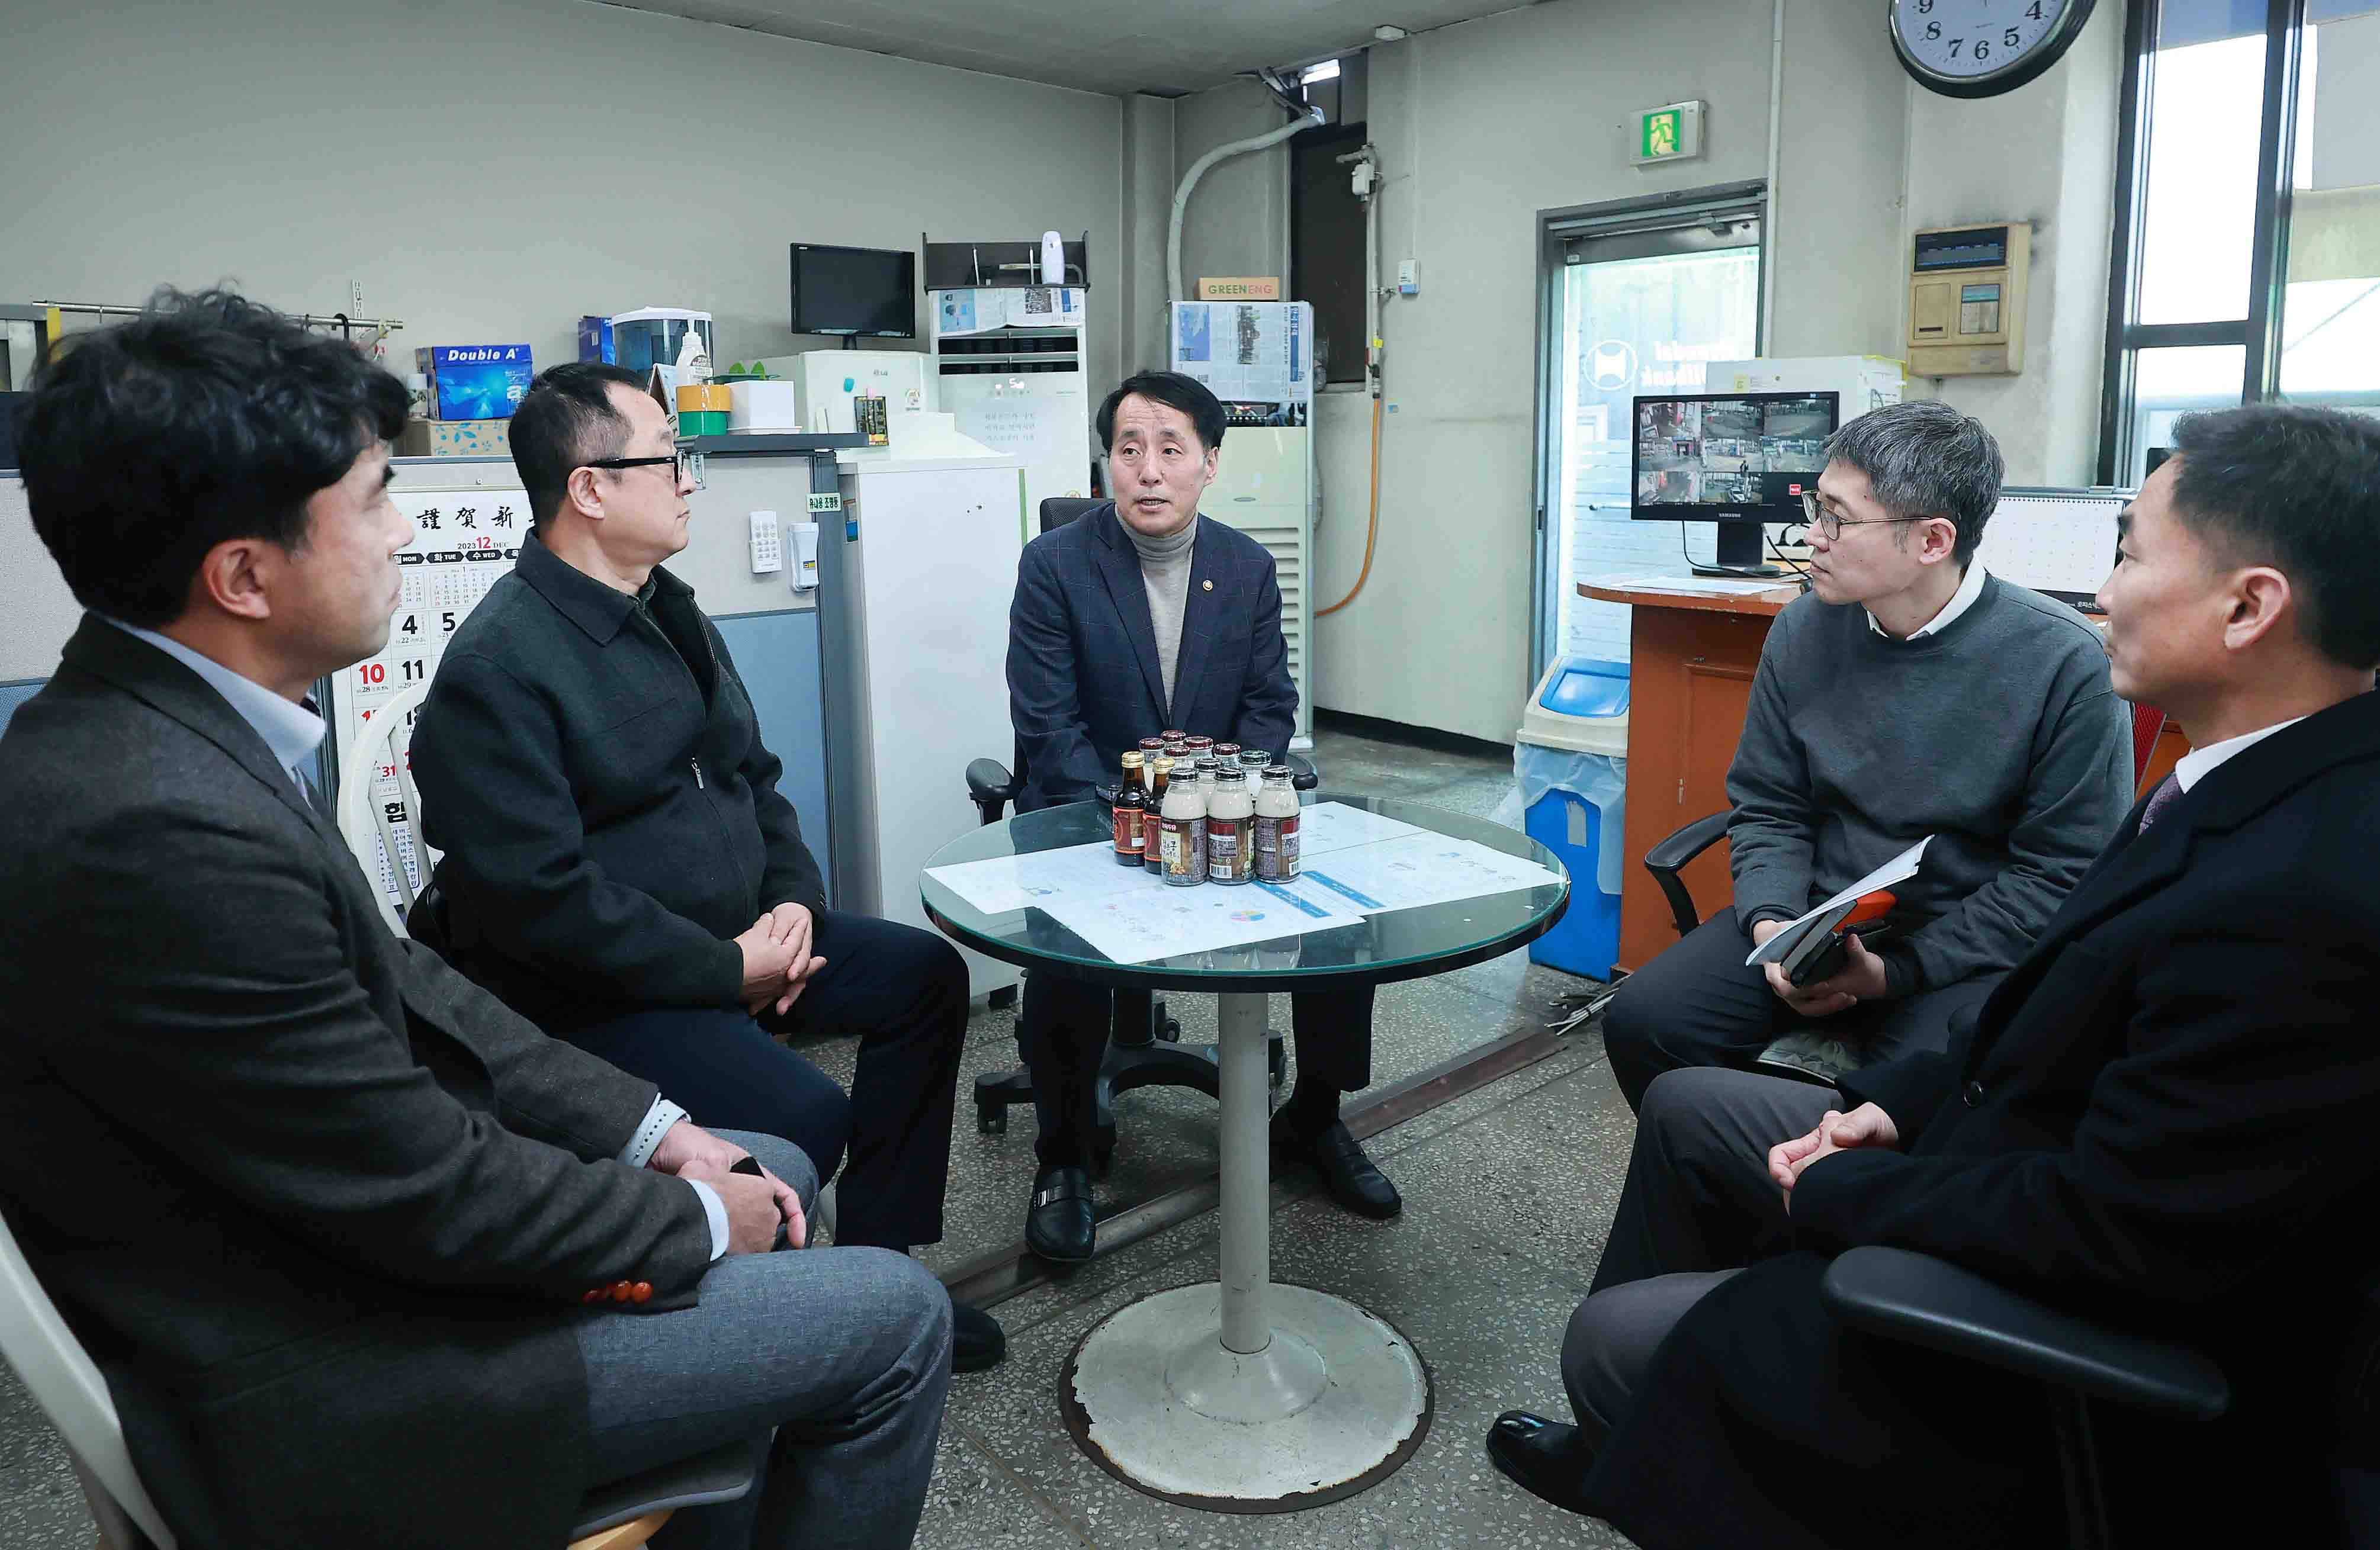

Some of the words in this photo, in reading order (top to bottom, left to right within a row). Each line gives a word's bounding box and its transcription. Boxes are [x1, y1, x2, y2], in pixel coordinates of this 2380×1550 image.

[1919, 0, 1933, 14] 9
[2024, 1, 2042, 20] 4
[1926, 21, 1941, 40] 8
[2004, 26, 2020, 47] 5
[1948, 38, 1964, 58] 7
[1974, 40, 1990, 60] 6
[448, 349, 500, 361] Double
[505, 348, 516, 360] A
[477, 536, 491, 548] 12
[434, 553, 443, 562] 화
[473, 551, 481, 560] 수
[402, 615, 417, 635] 4
[442, 612, 455, 631] 5
[359, 664, 385, 684] 10
[402, 660, 423, 680] 11
